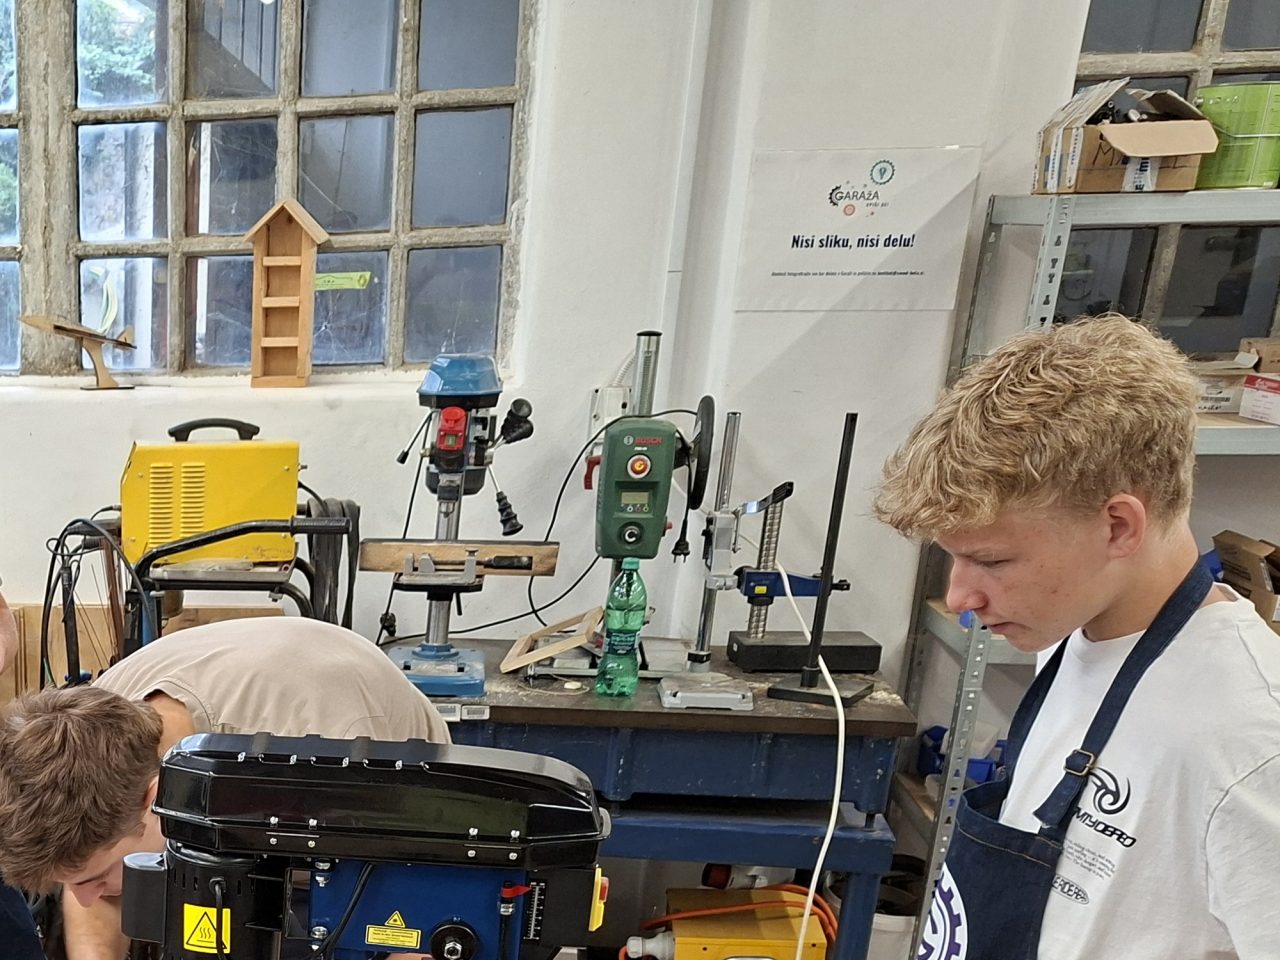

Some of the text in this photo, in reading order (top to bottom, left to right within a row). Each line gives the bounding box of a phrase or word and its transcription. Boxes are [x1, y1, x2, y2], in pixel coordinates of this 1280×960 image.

[791, 234, 916, 250] Nisi sliku, nisi delu!
